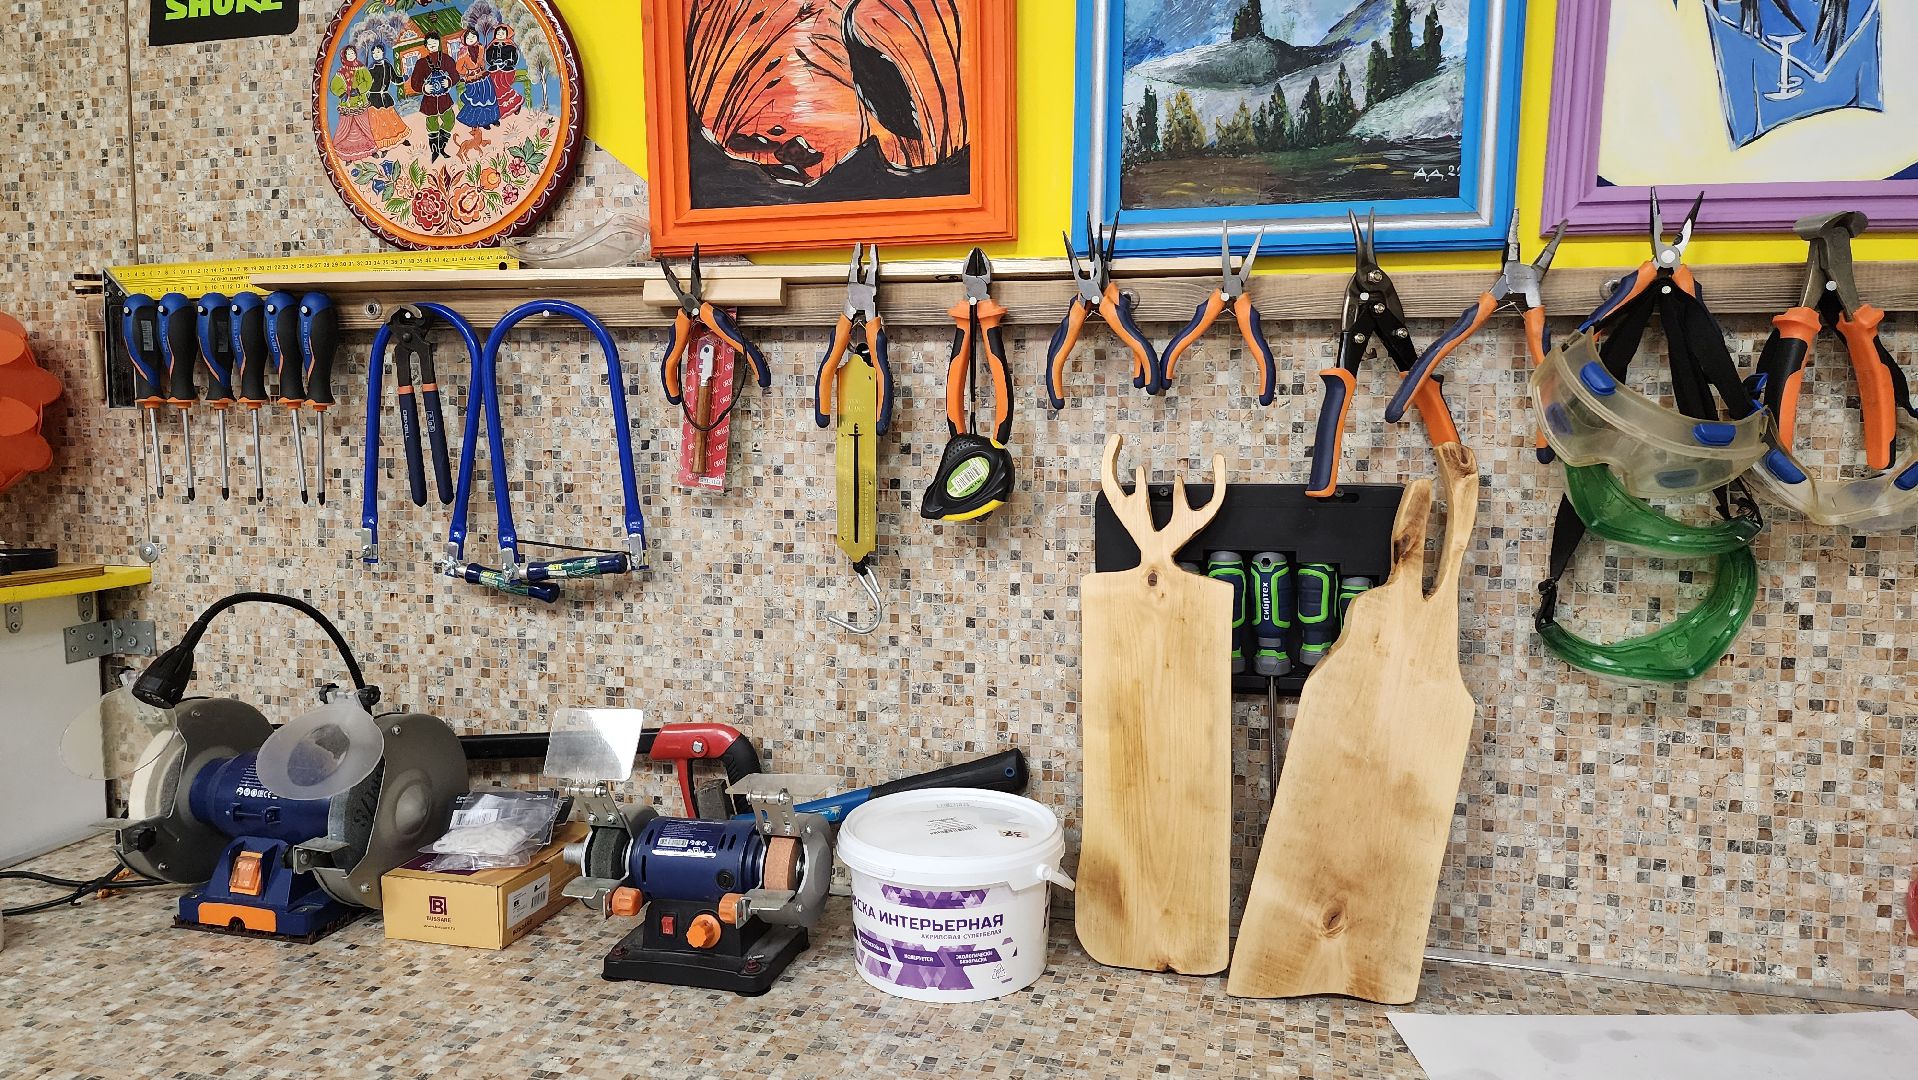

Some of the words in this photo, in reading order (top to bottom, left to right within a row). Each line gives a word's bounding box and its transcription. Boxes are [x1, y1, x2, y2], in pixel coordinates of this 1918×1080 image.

[268, 319, 279, 353] DEXTER
[302, 321, 311, 355] DEXTER
[1262, 582, 1271, 621] сибртех
[879, 910, 1004, 932] ИНТЕРЬЕРНАЯ
